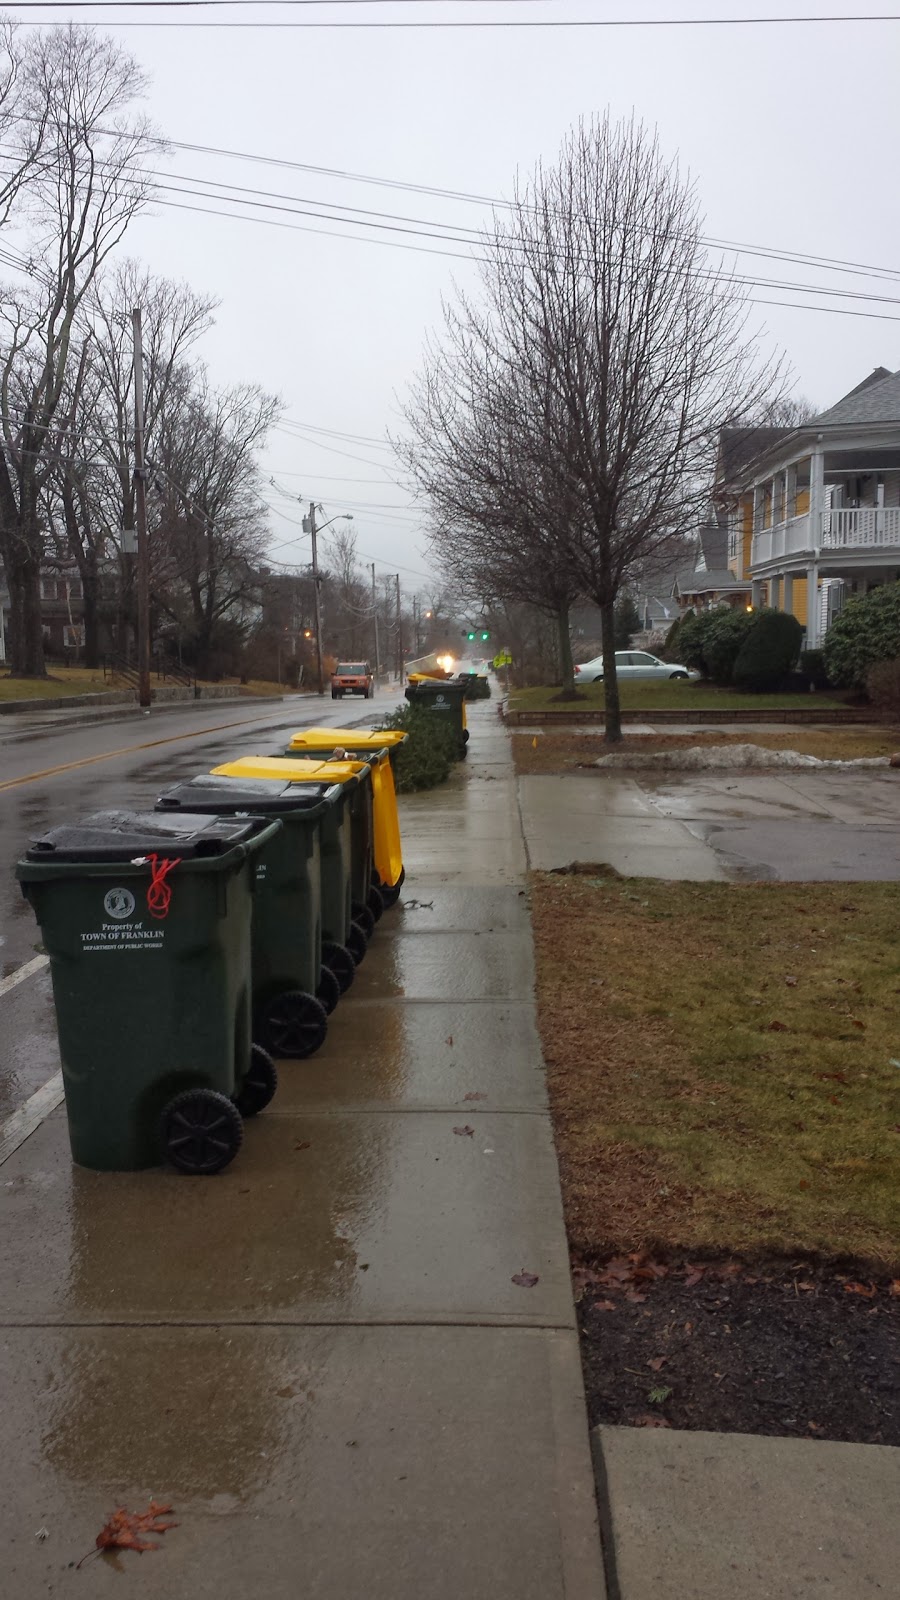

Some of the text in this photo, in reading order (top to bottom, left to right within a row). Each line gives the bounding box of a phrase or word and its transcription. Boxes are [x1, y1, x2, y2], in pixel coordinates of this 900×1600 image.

[102, 922, 142, 932] Property of
[81, 930, 164, 941] TOWN OF FRANKLIN
